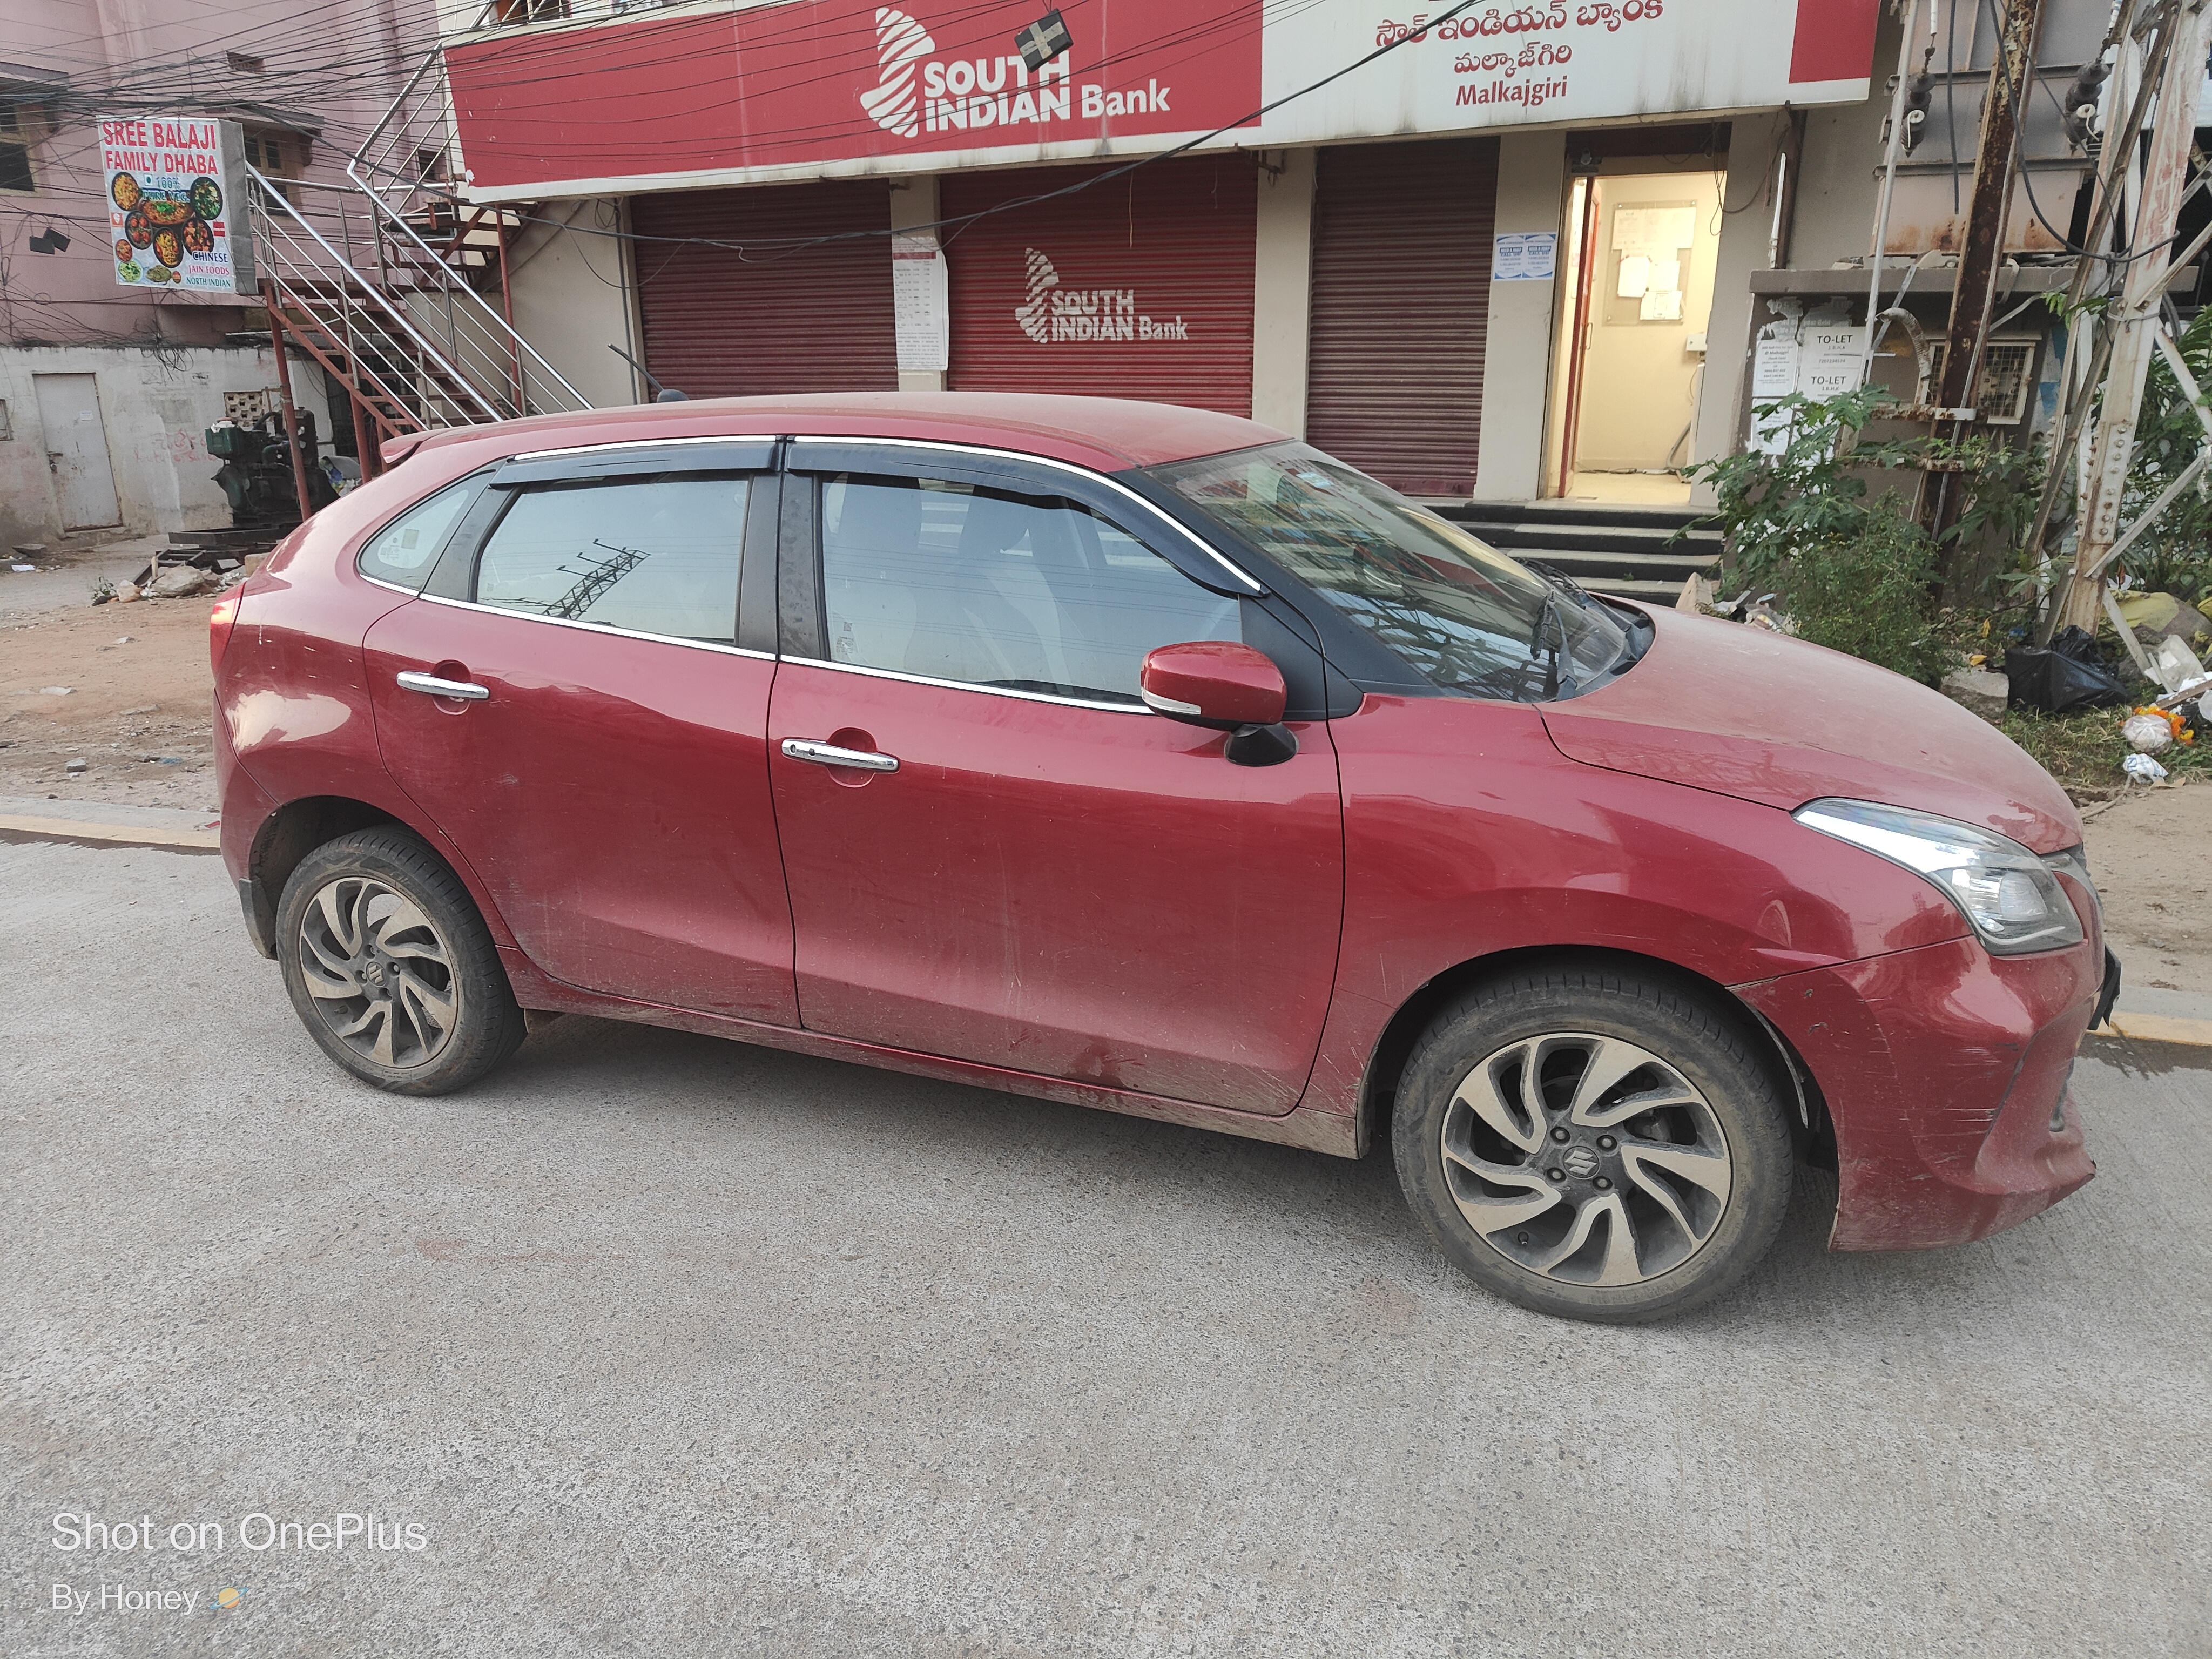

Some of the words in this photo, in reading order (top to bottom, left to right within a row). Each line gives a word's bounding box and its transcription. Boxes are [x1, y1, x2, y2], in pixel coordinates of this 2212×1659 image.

[924, 50, 1070, 98] SOUTH
[1455, 75, 1567, 107] Malkajgiri
[926, 86, 1071, 132] INDIAN
[1082, 78, 1171, 118] Bank
[103, 121, 148, 147] SREE
[152, 123, 217, 150] BALAJI
[105, 150, 158, 172] FAMILY
[164, 153, 218, 174] DHABA
[143, 189, 166, 200] PURE
[192, 251, 228, 263] CHINESE
[186, 277, 207, 285] NORTH
[208, 278, 231, 287] INDIAN
[188, 265, 205, 274] JAIN
[206, 266, 230, 275] FOODS
[1051, 290, 1134, 315] SOUTH
[1051, 316, 1134, 341] INDIAN
[1139, 316, 1188, 340] Bank
[1817, 335, 1853, 344] TO-LET
[1811, 376, 1847, 385] TO-LET
